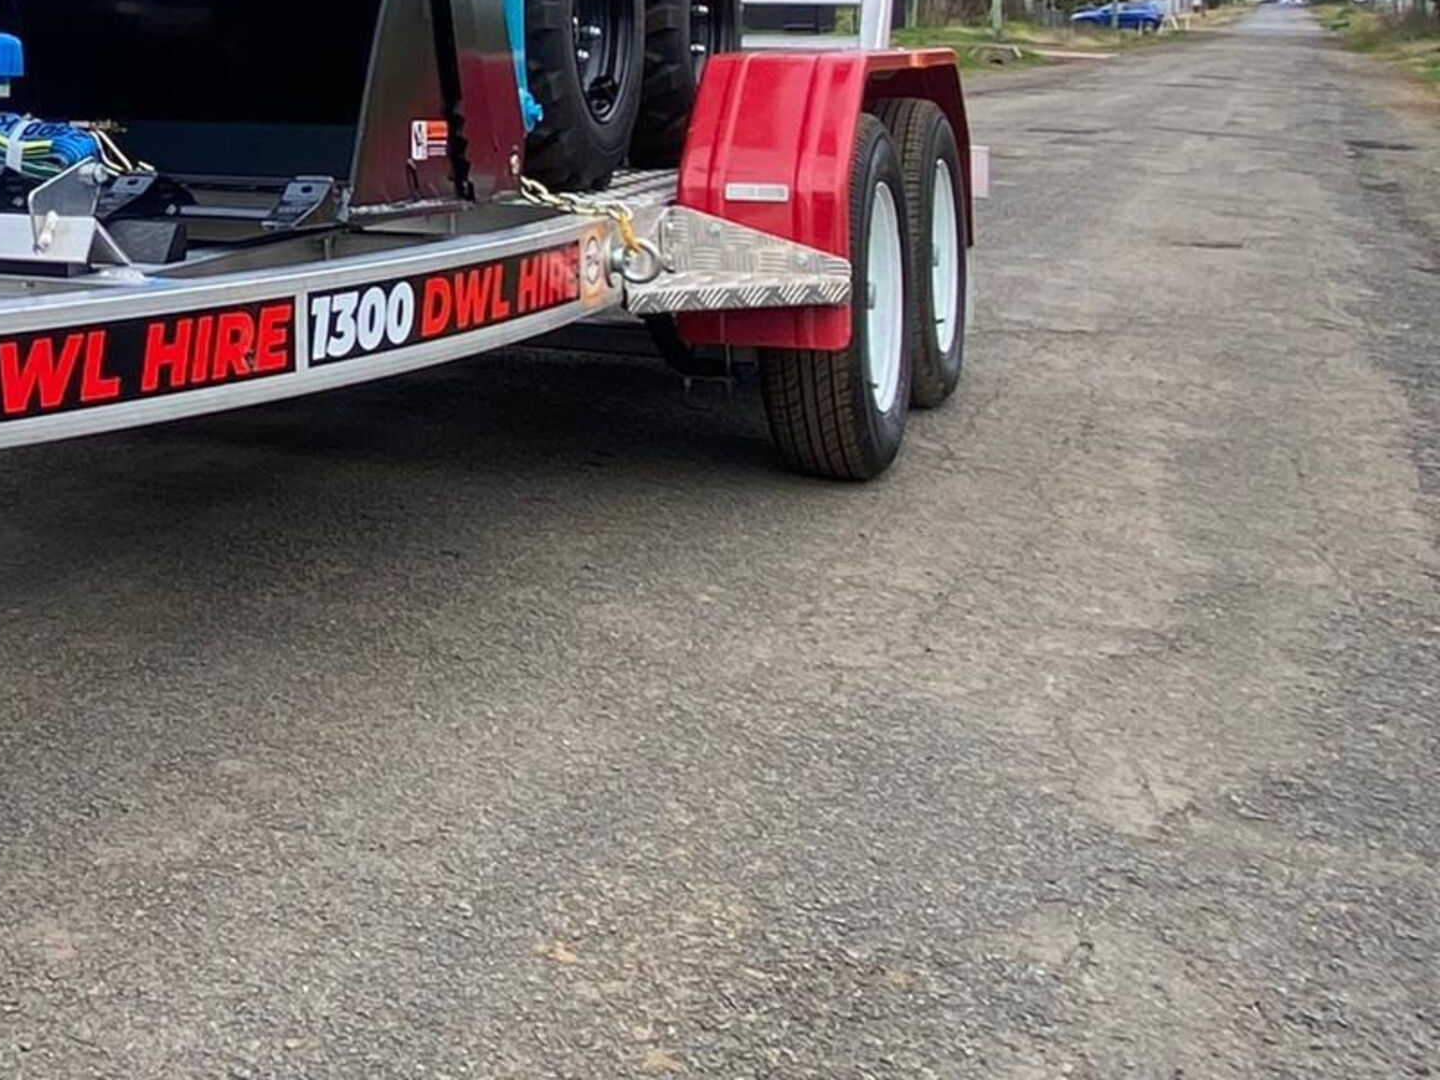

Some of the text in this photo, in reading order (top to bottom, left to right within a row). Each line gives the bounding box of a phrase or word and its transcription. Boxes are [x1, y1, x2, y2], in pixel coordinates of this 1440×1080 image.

[140, 302, 293, 392] HIRE
[312, 243, 580, 361] 1300 DWL HIRE
